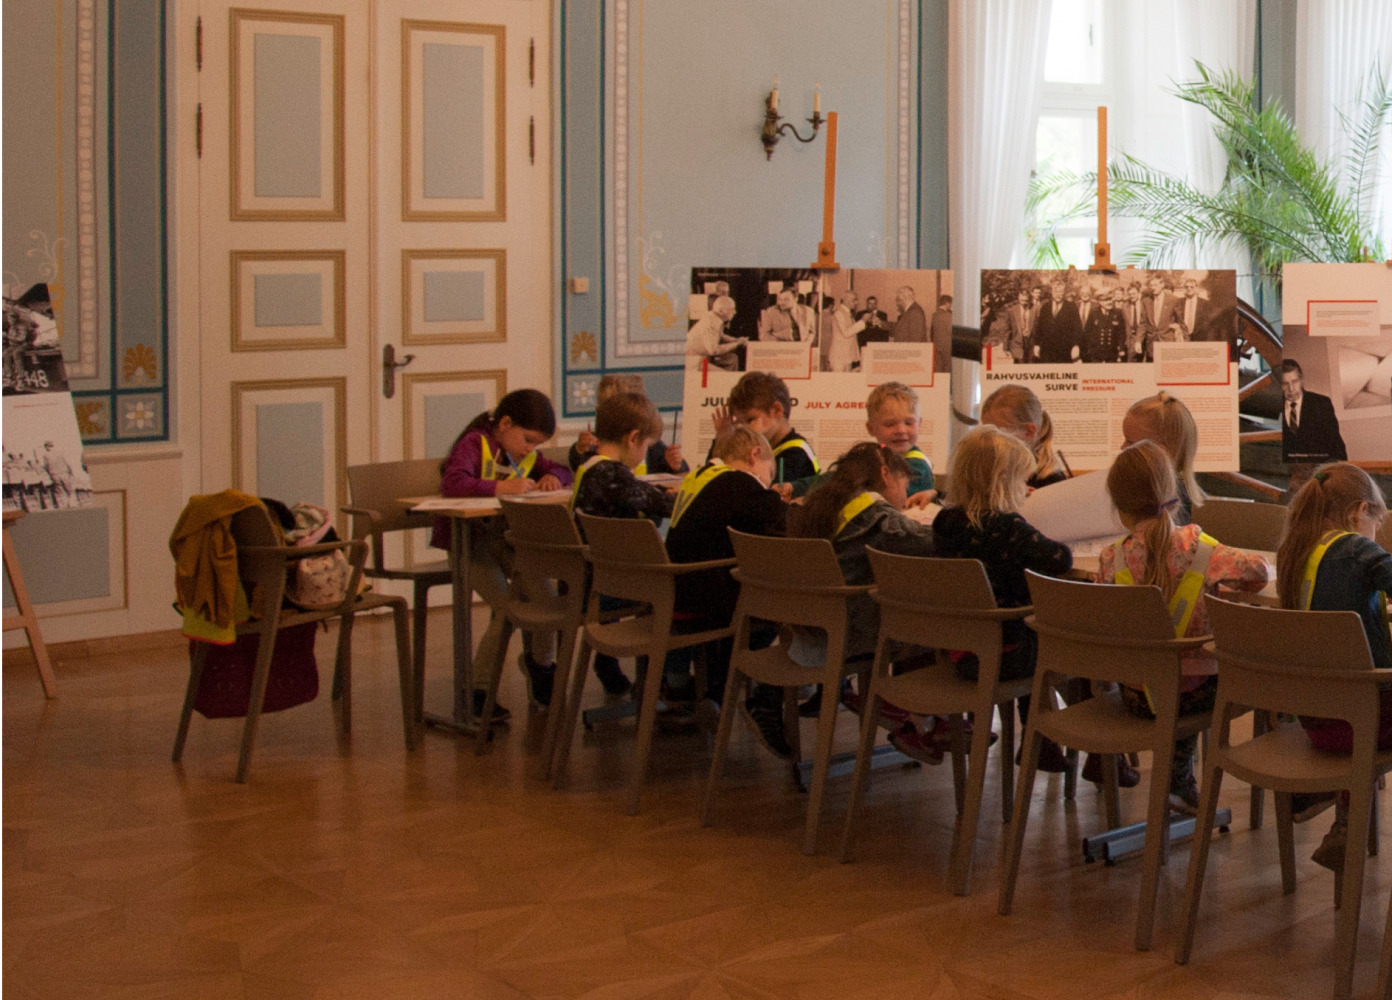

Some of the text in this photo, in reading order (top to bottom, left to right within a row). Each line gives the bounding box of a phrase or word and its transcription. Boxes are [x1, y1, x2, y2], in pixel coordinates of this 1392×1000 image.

[986, 372, 1079, 381] RAHVUSVAHELINE
[1045, 383, 1079, 391] SURVE
[804, 401, 831, 409] JULY
